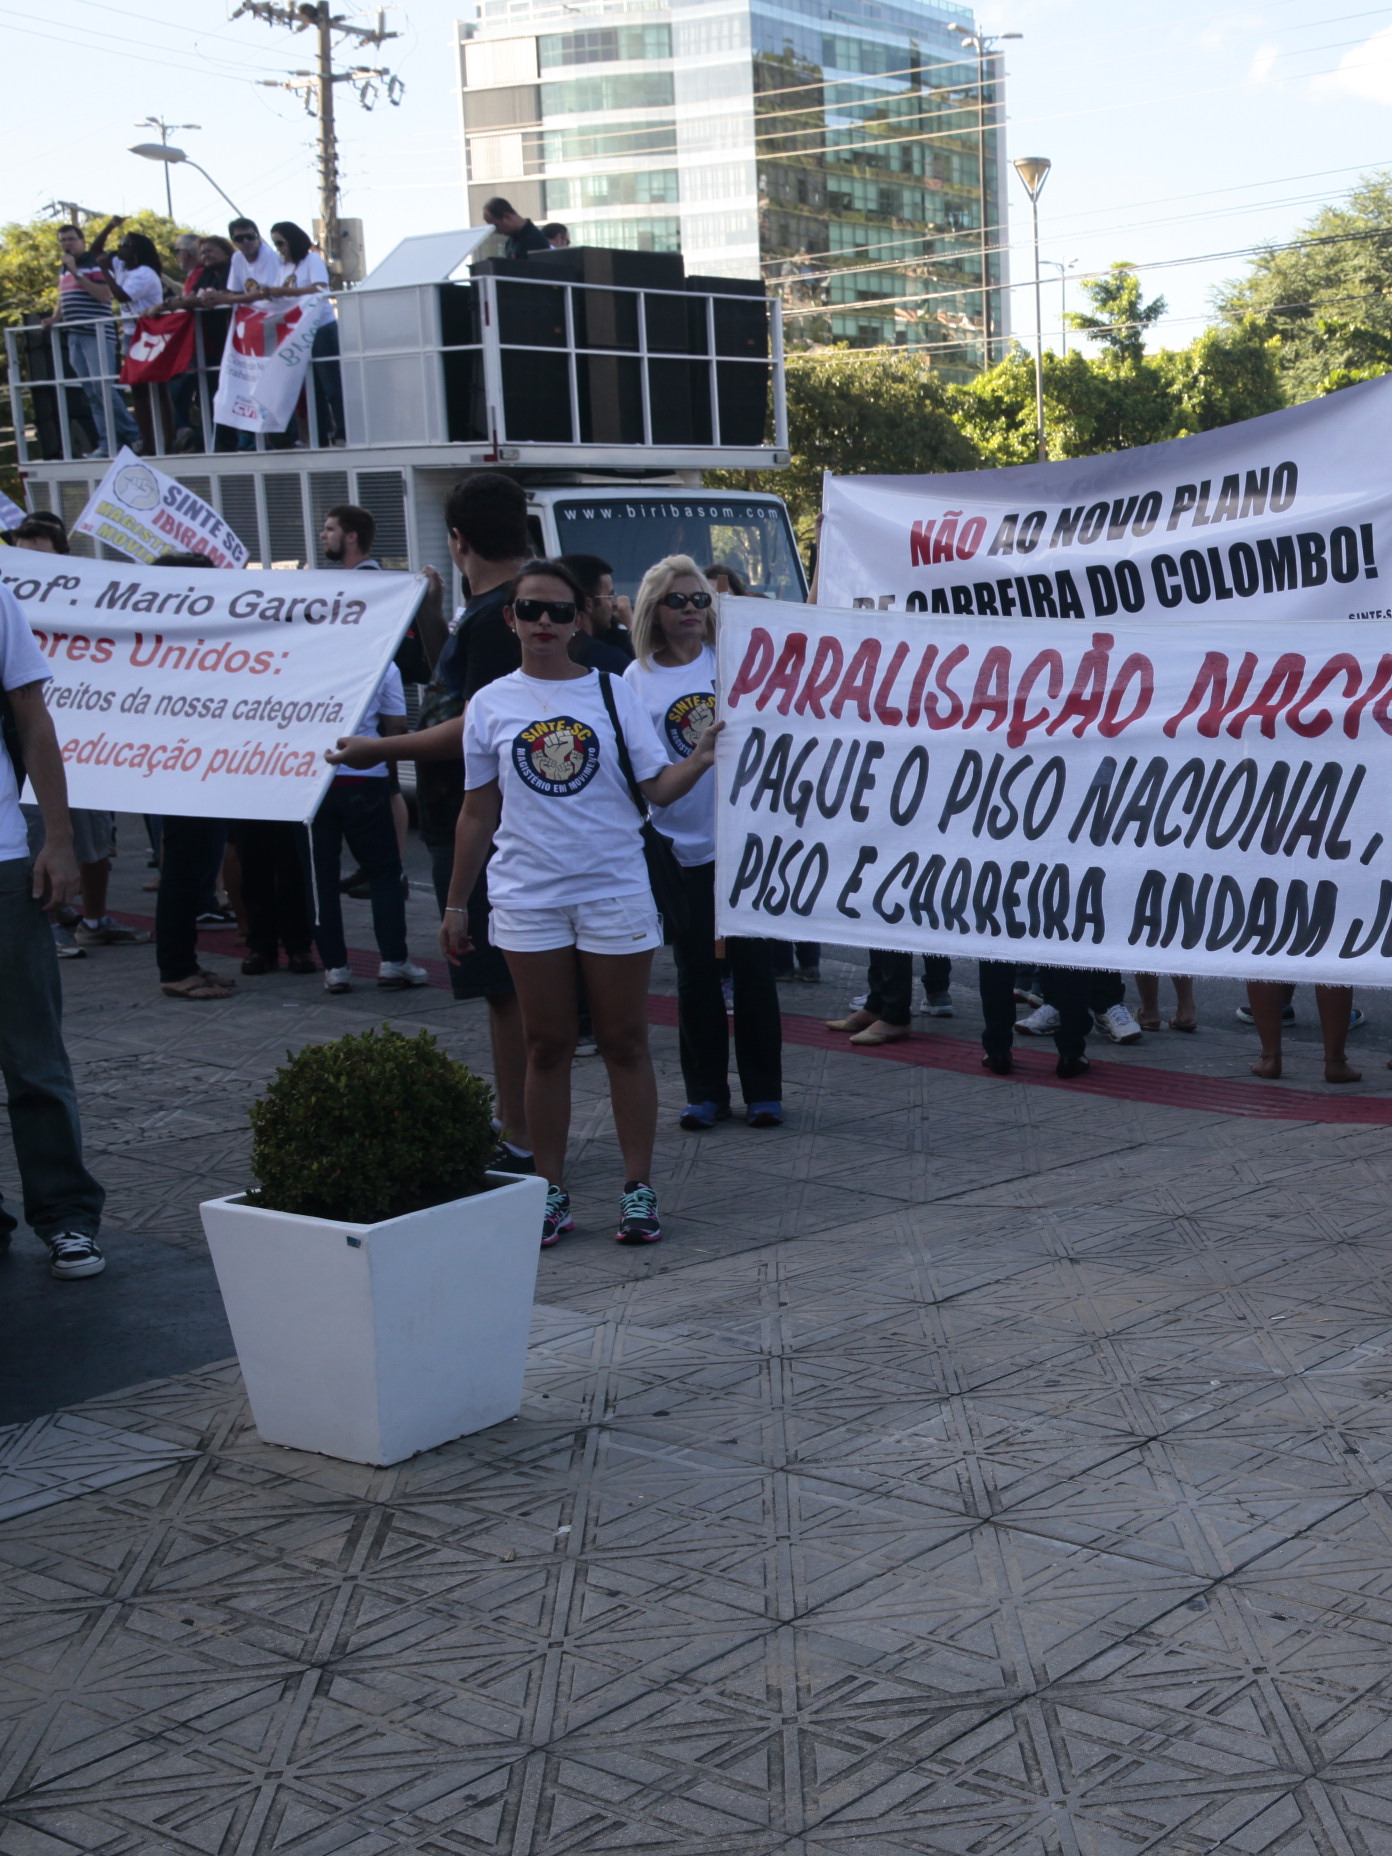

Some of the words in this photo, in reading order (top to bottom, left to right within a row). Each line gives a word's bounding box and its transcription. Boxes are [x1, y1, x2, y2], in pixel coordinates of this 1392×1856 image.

[163, 485, 224, 538] SINTE
[222, 531, 244, 562] SC
[909, 510, 988, 567] NÃO
[986, 511, 1042, 557] AO
[1048, 490, 1163, 549] NOVO
[1165, 461, 1299, 532] PLANO
[1094, 561, 1147, 618] DO
[1152, 523, 1379, 609] COLOMBO!
[94, 580, 217, 617] Mario
[228, 588, 367, 625] Garcia
[129, 633, 290, 675] Unidos:
[120, 687, 152, 714] da
[154, 694, 228, 720] nossa
[232, 695, 345, 729] categoria.
[728, 627, 1155, 748] PARALISAÇÃO
[62, 733, 202, 778] educação
[200, 740, 319, 781] pública.
[521, 720, 592, 742] SINTE-SC
[516, 747, 551, 791] MAGISTÉRIO
[553, 784, 567, 793] EM
[729, 726, 884, 828] PAGUE
[889, 745, 930, 826] O
[938, 749, 1066, 841] PISO
[1068, 756, 1384, 866] NACIONAL,
[729, 832, 829, 917] PISO
[837, 845, 878, 919] E
[871, 850, 1106, 945] CARREIRA
[1128, 869, 1339, 957] ANDAM
